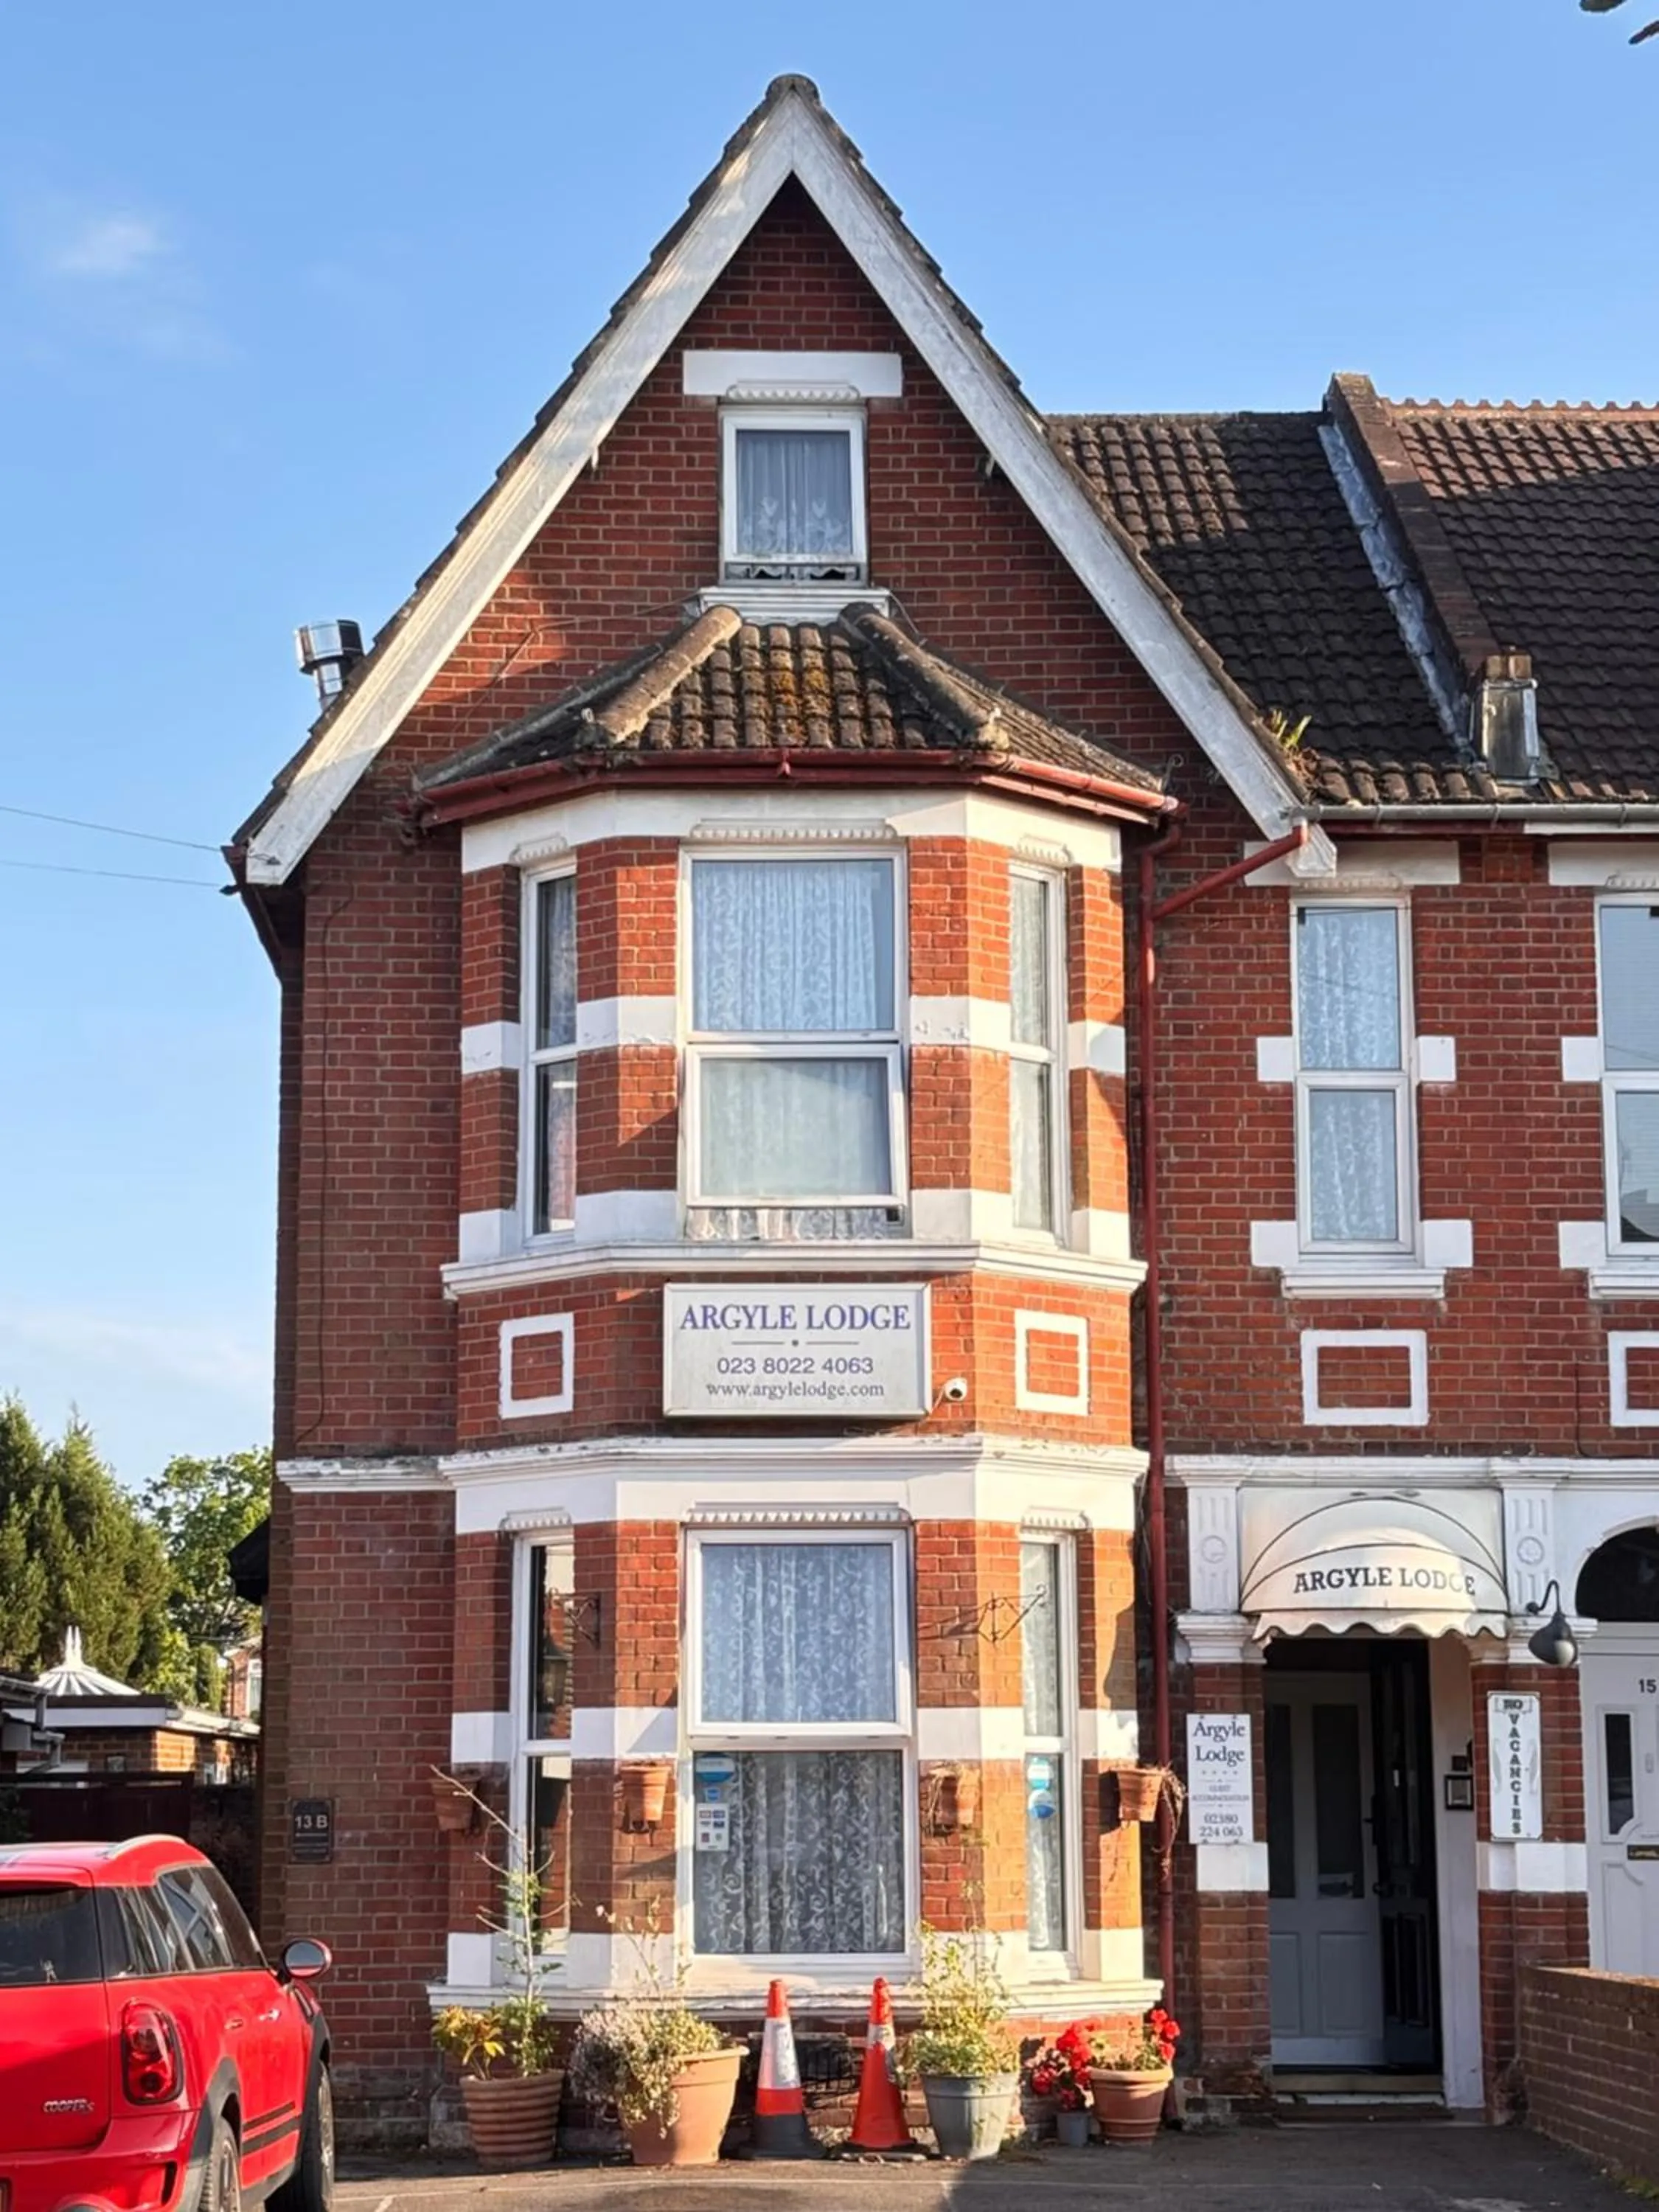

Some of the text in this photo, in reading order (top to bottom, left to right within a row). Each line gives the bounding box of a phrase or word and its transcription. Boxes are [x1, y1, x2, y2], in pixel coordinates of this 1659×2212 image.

[680, 1304, 911, 1330] ARGYLE LODGE
[717, 1357, 874, 1374] 023 8022 4063
[706, 1380, 885, 1400] www.argylelodge.com
[1293, 1567, 1392, 1593] ARGYLE
[1638, 1679, 1657, 1694] 15
[1503, 1699, 1523, 1711] NO
[1192, 1721, 1246, 1742] Argyle
[1194, 1745, 1246, 1767] Lodge
[1508, 1713, 1522, 1835] VACANCIES
[295, 1815, 328, 1828] 13 B
